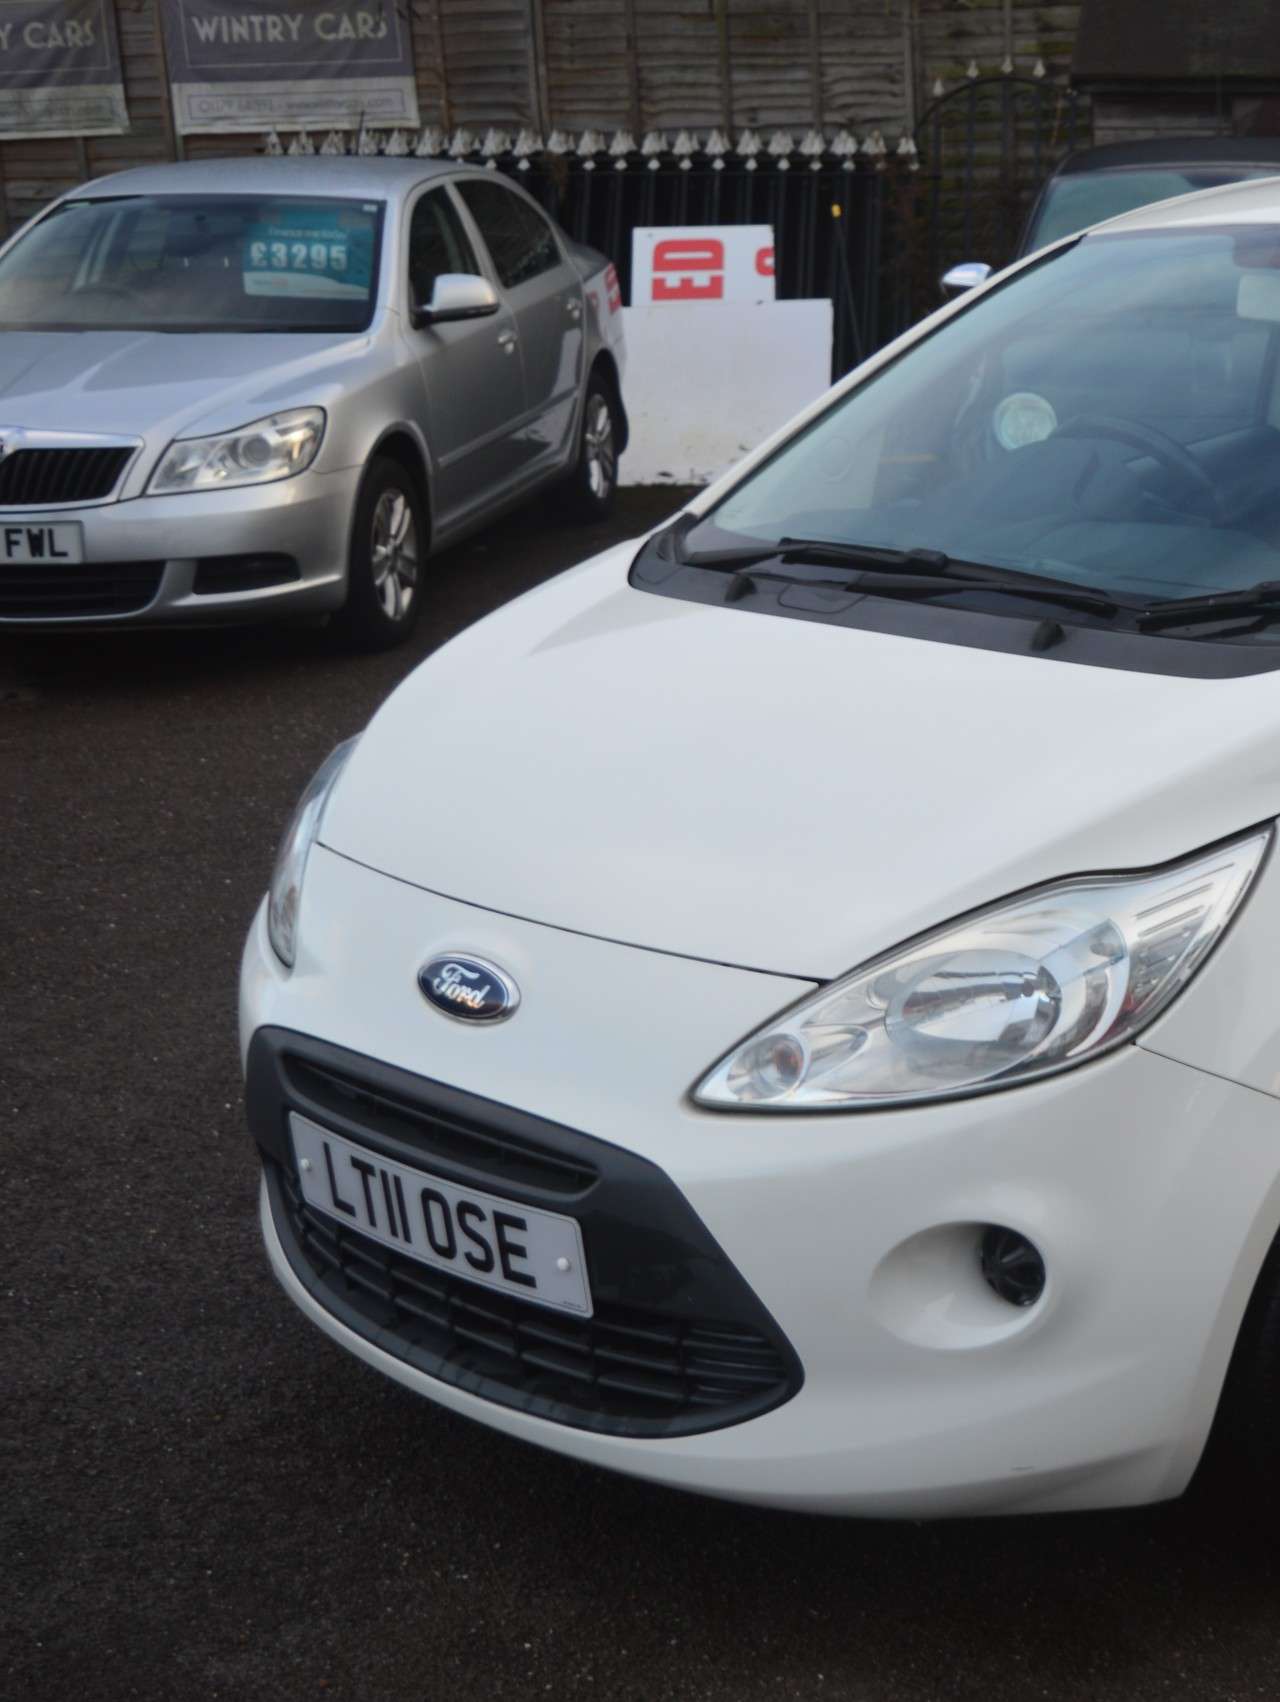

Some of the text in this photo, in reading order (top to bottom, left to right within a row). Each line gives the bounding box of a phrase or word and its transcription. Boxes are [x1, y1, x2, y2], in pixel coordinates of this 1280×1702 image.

[23, 20, 96, 49] CARS
[191, 10, 389, 44] WINTRY CARS
[251, 241, 348, 270] £3295
[4, 527, 69, 558] FWL
[433, 963, 491, 1009] Ford
[420, 1187, 537, 1289] OSE
